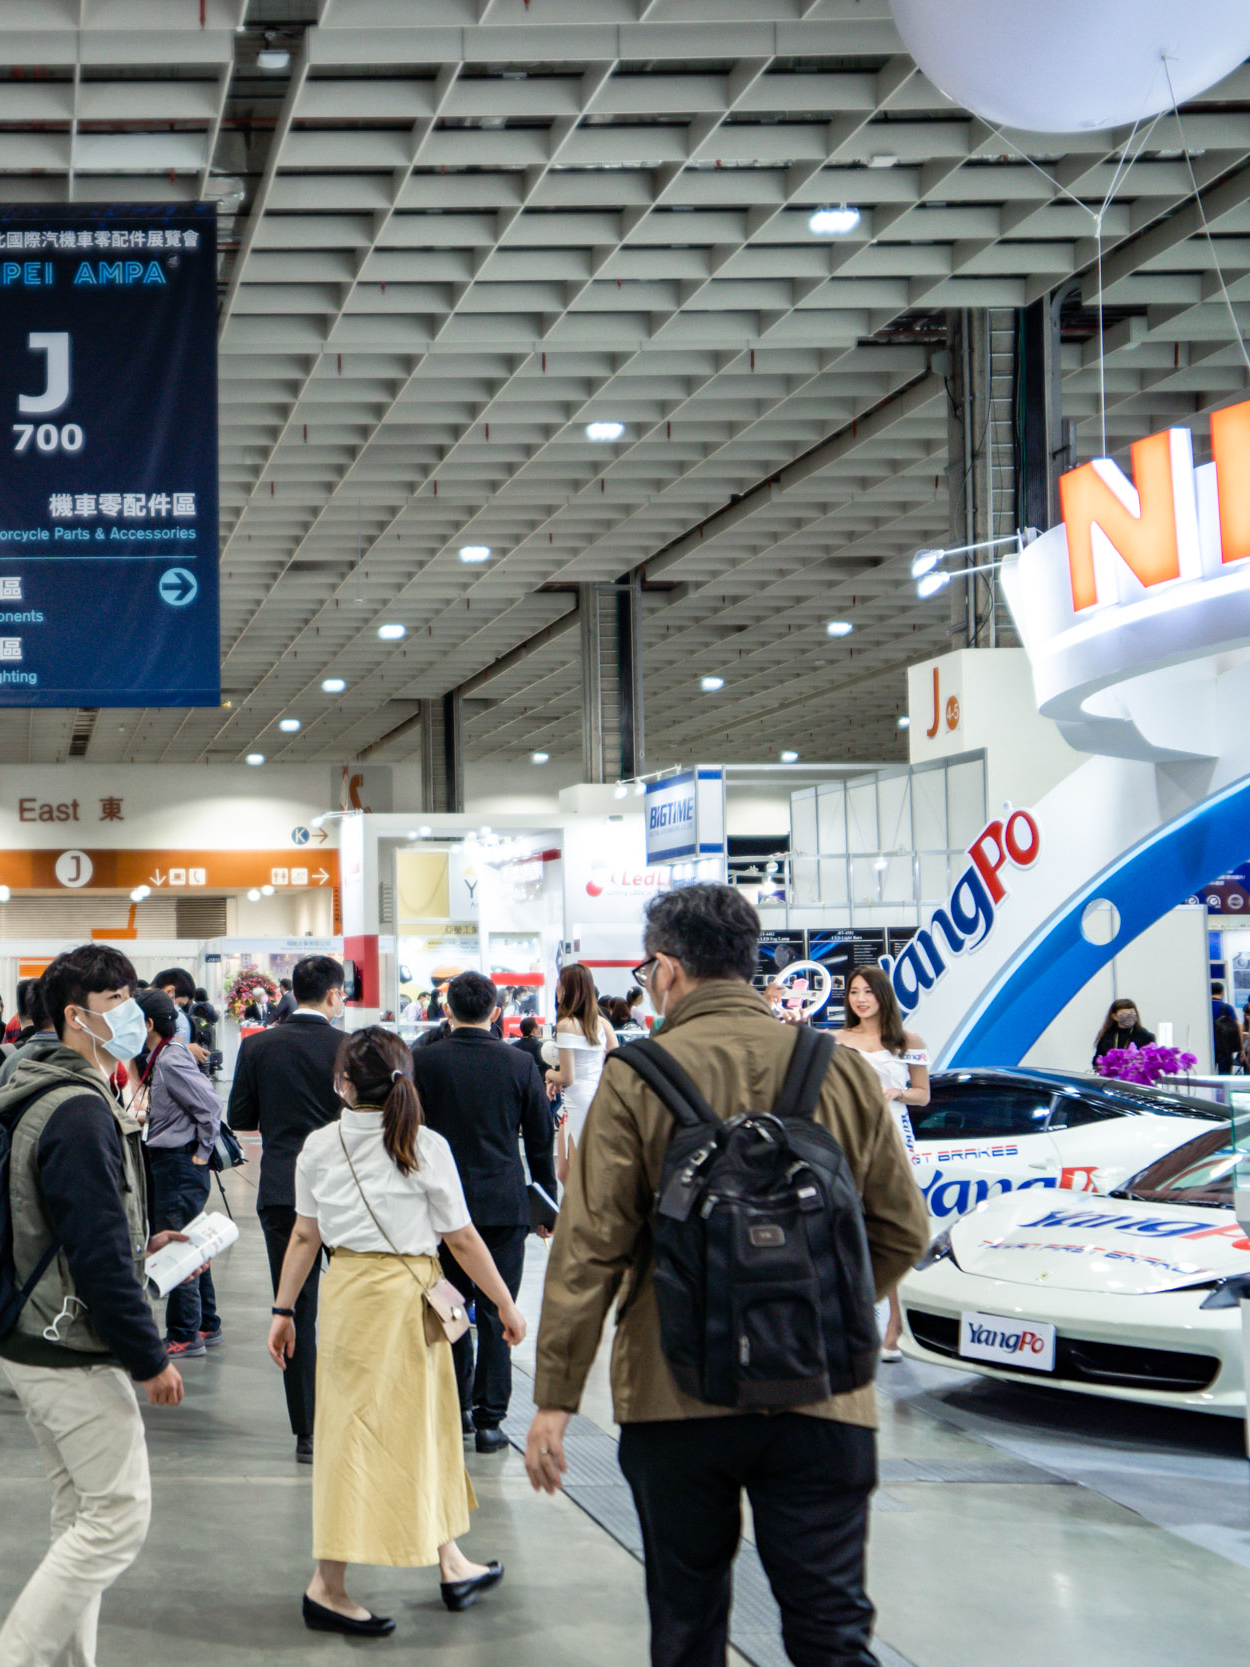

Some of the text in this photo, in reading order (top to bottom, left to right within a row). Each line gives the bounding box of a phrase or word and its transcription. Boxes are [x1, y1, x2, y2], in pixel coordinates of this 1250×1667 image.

[73, 261, 167, 285] AMPA
[19, 331, 69, 413] J
[12, 424, 84, 451] 700
[49, 492, 197, 518] 機車零配件區
[54, 528, 90, 540] Parts
[95, 528, 105, 540] &
[110, 526, 197, 540] Accessories
[926, 666, 940, 739] J
[18, 796, 124, 822] East 東
[649, 796, 694, 830] BIGTIME
[295, 827, 307, 843] K
[66, 855, 83, 883] J
[937, 1144, 1019, 1162] BRAKES
[968, 1321, 1046, 1355] YangPo
